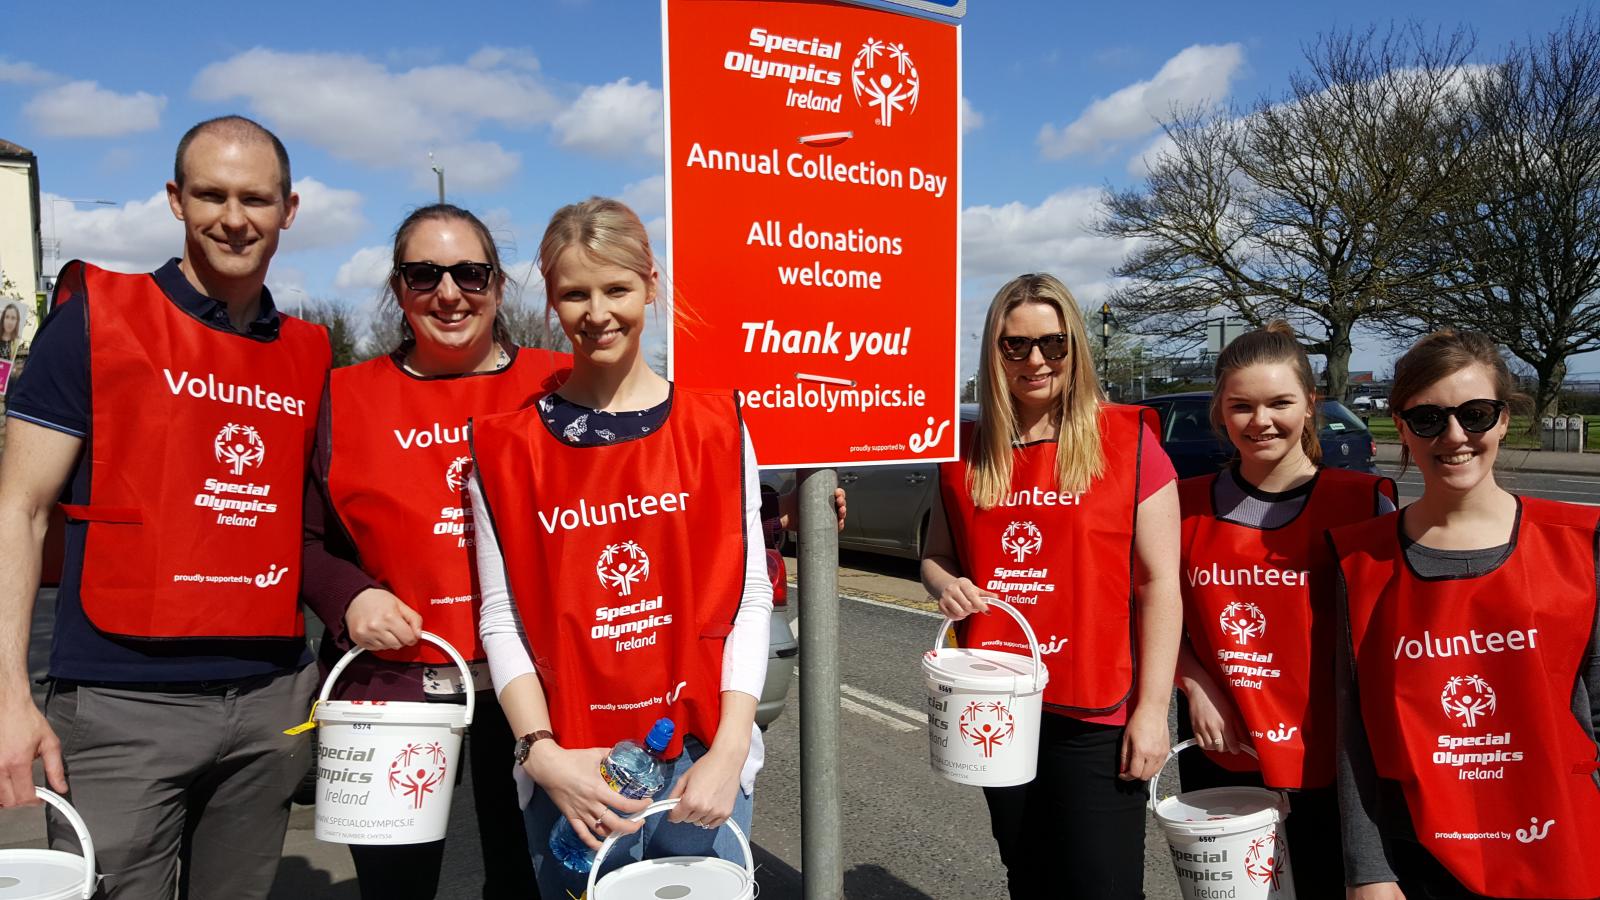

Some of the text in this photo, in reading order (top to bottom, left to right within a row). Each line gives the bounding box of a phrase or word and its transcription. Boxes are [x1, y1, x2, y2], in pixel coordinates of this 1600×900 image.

[749, 28, 842, 60] Special
[724, 51, 842, 86] Olympics
[786, 88, 842, 113] Ireland
[686, 143, 947, 198] Annual Collection Day
[746, 220, 903, 255] All donations
[778, 261, 882, 289] welcome
[741, 320, 911, 361] Thank you!
[163, 368, 306, 417] Volunteer
[850, 416, 951, 453] proudly supported by eir
[204, 478, 271, 497] Special
[194, 494, 278, 513] Olympics
[537, 492, 690, 534] Volunteer
[216, 513, 258, 527] Ireland
[174, 564, 288, 588] proudly supported by eir
[994, 567, 1048, 580] Special
[1187, 562, 1310, 588] Volunteer
[987, 580, 1055, 593] Olympics
[595, 596, 663, 622] Special
[1005, 594, 1038, 605] Ireland
[591, 614, 673, 639] Olympics
[615, 632, 657, 653] Ireland
[1039, 635, 1069, 655] eir
[1217, 649, 1273, 663] Special
[1229, 677, 1262, 690] Ireland
[590, 704, 616, 712] proudly
[617, 698, 653, 710] supported
[653, 696, 663, 704] by
[1266, 722, 1297, 742] eir
[1438, 733, 1511, 749] Special
[1432, 750, 1524, 767] Olympics
[1458, 767, 1504, 780] Ireland
[325, 788, 371, 806] Ireland
[1435, 816, 1555, 844] proudly supported by eir
[1193, 885, 1236, 899] Ireland
